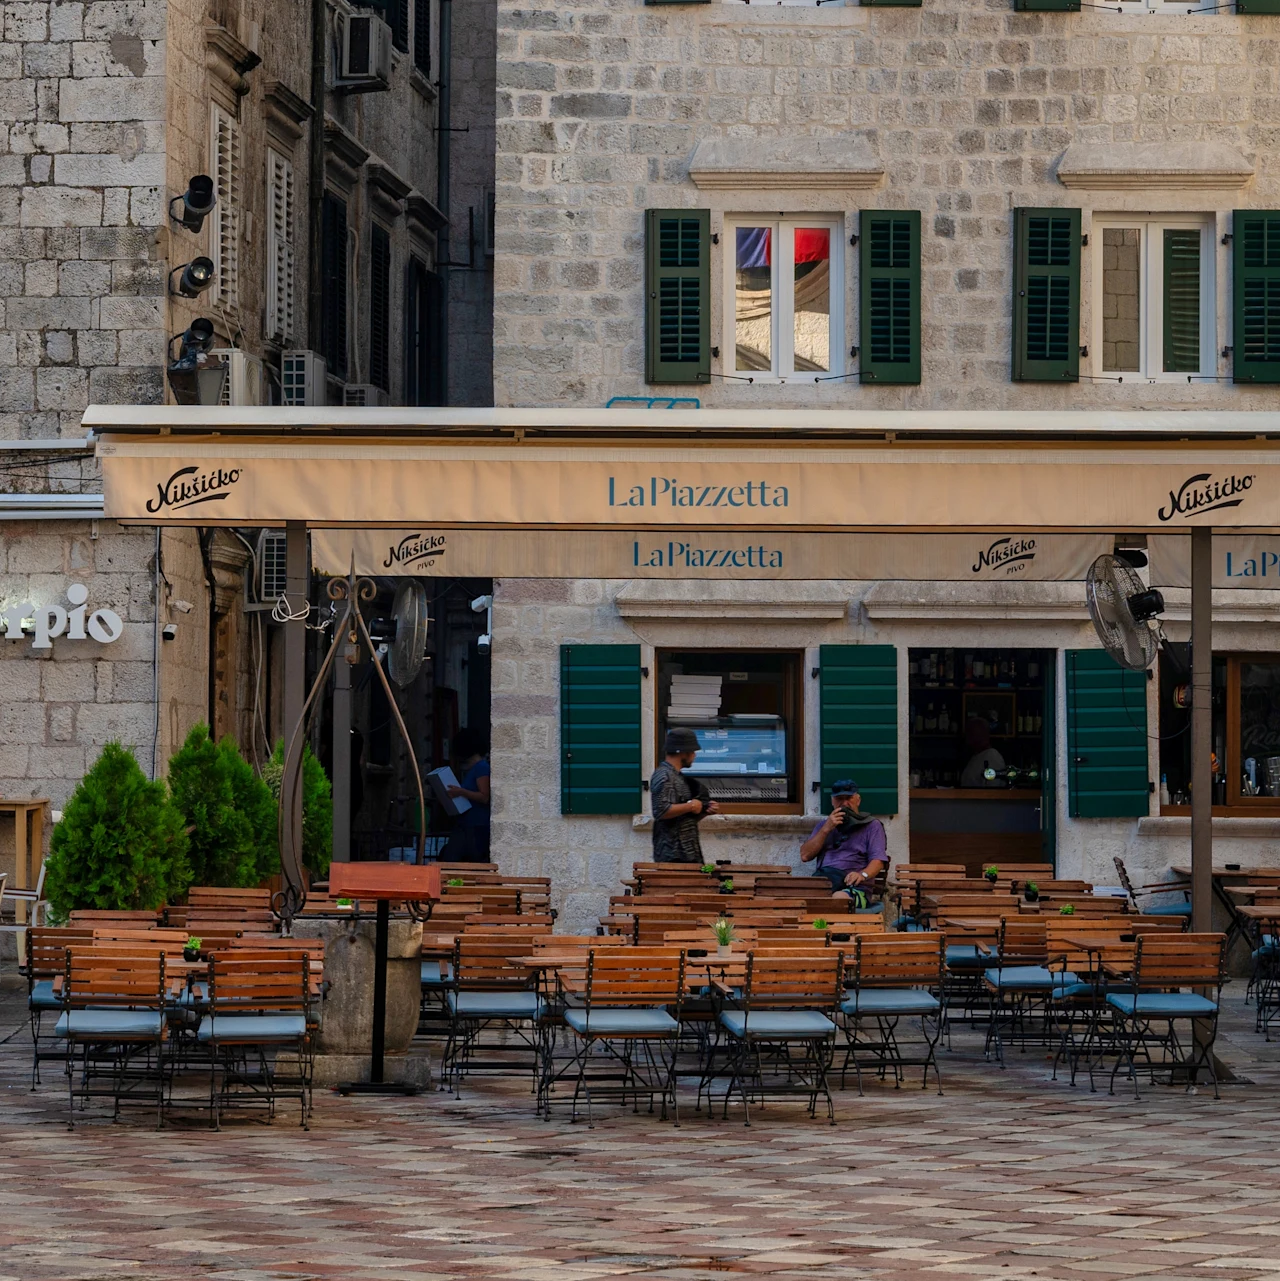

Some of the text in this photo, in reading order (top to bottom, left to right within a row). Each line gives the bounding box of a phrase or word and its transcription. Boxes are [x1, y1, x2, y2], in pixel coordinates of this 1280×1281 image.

[651, 477, 788, 507] Piazzetta
[669, 542, 783, 567] Piazzetta
[417, 560, 435, 570] PIVO
[1007, 564, 1025, 574] PIVO
